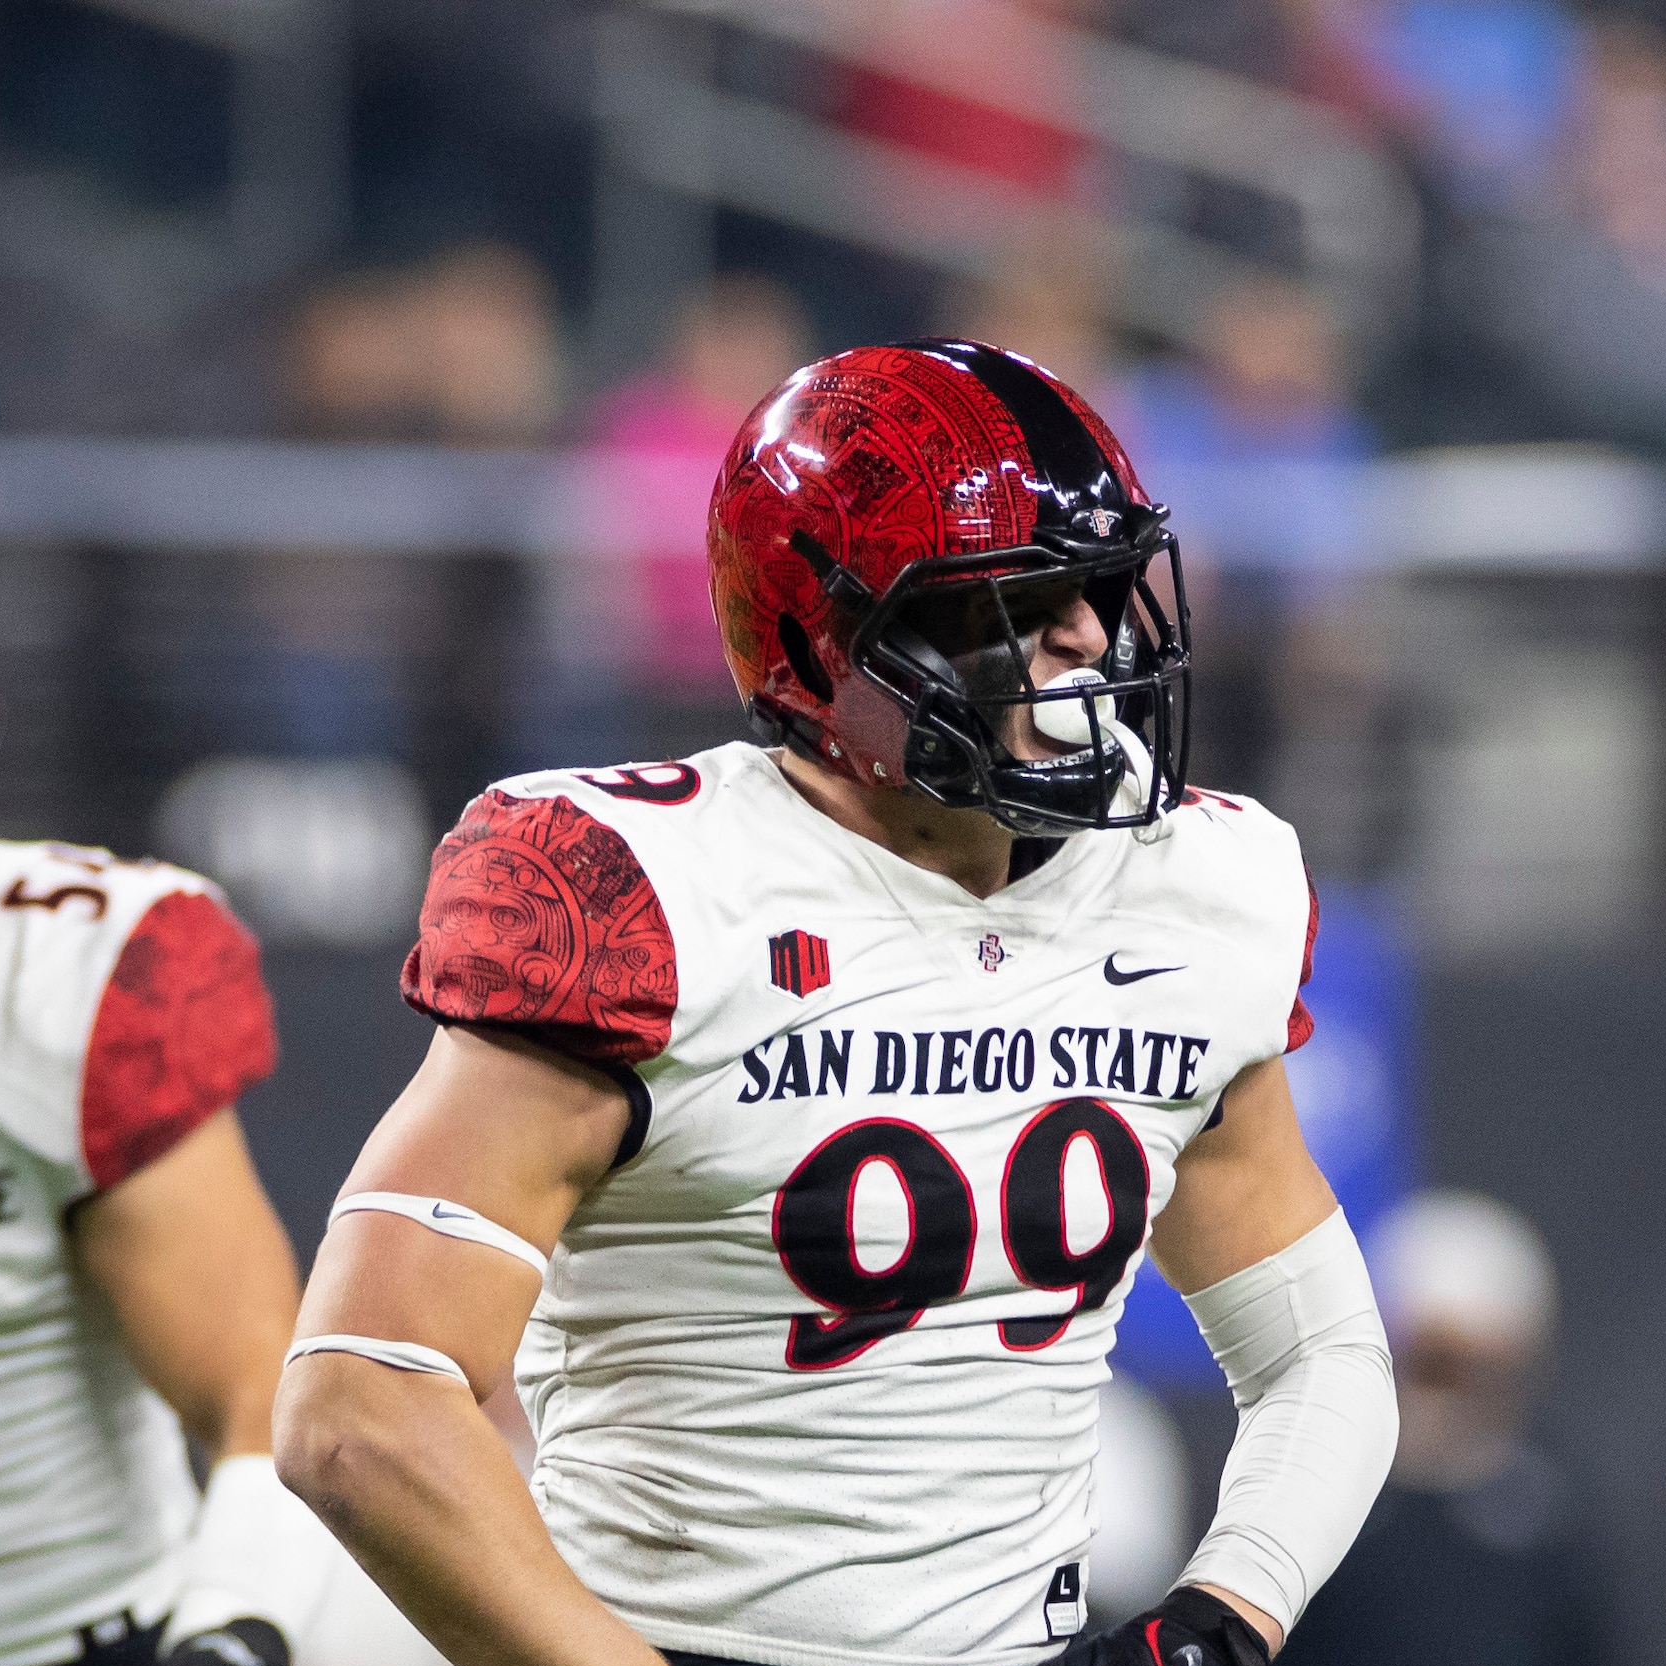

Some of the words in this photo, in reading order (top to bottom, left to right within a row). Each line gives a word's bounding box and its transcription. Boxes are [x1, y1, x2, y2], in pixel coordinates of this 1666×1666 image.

[737, 1029, 854, 1104] SAN
[868, 1027, 1035, 1096] DIEGO
[1049, 1026, 1212, 1101] STATE
[773, 1097, 1149, 1371] 99
[1060, 1573, 1071, 1595] L
